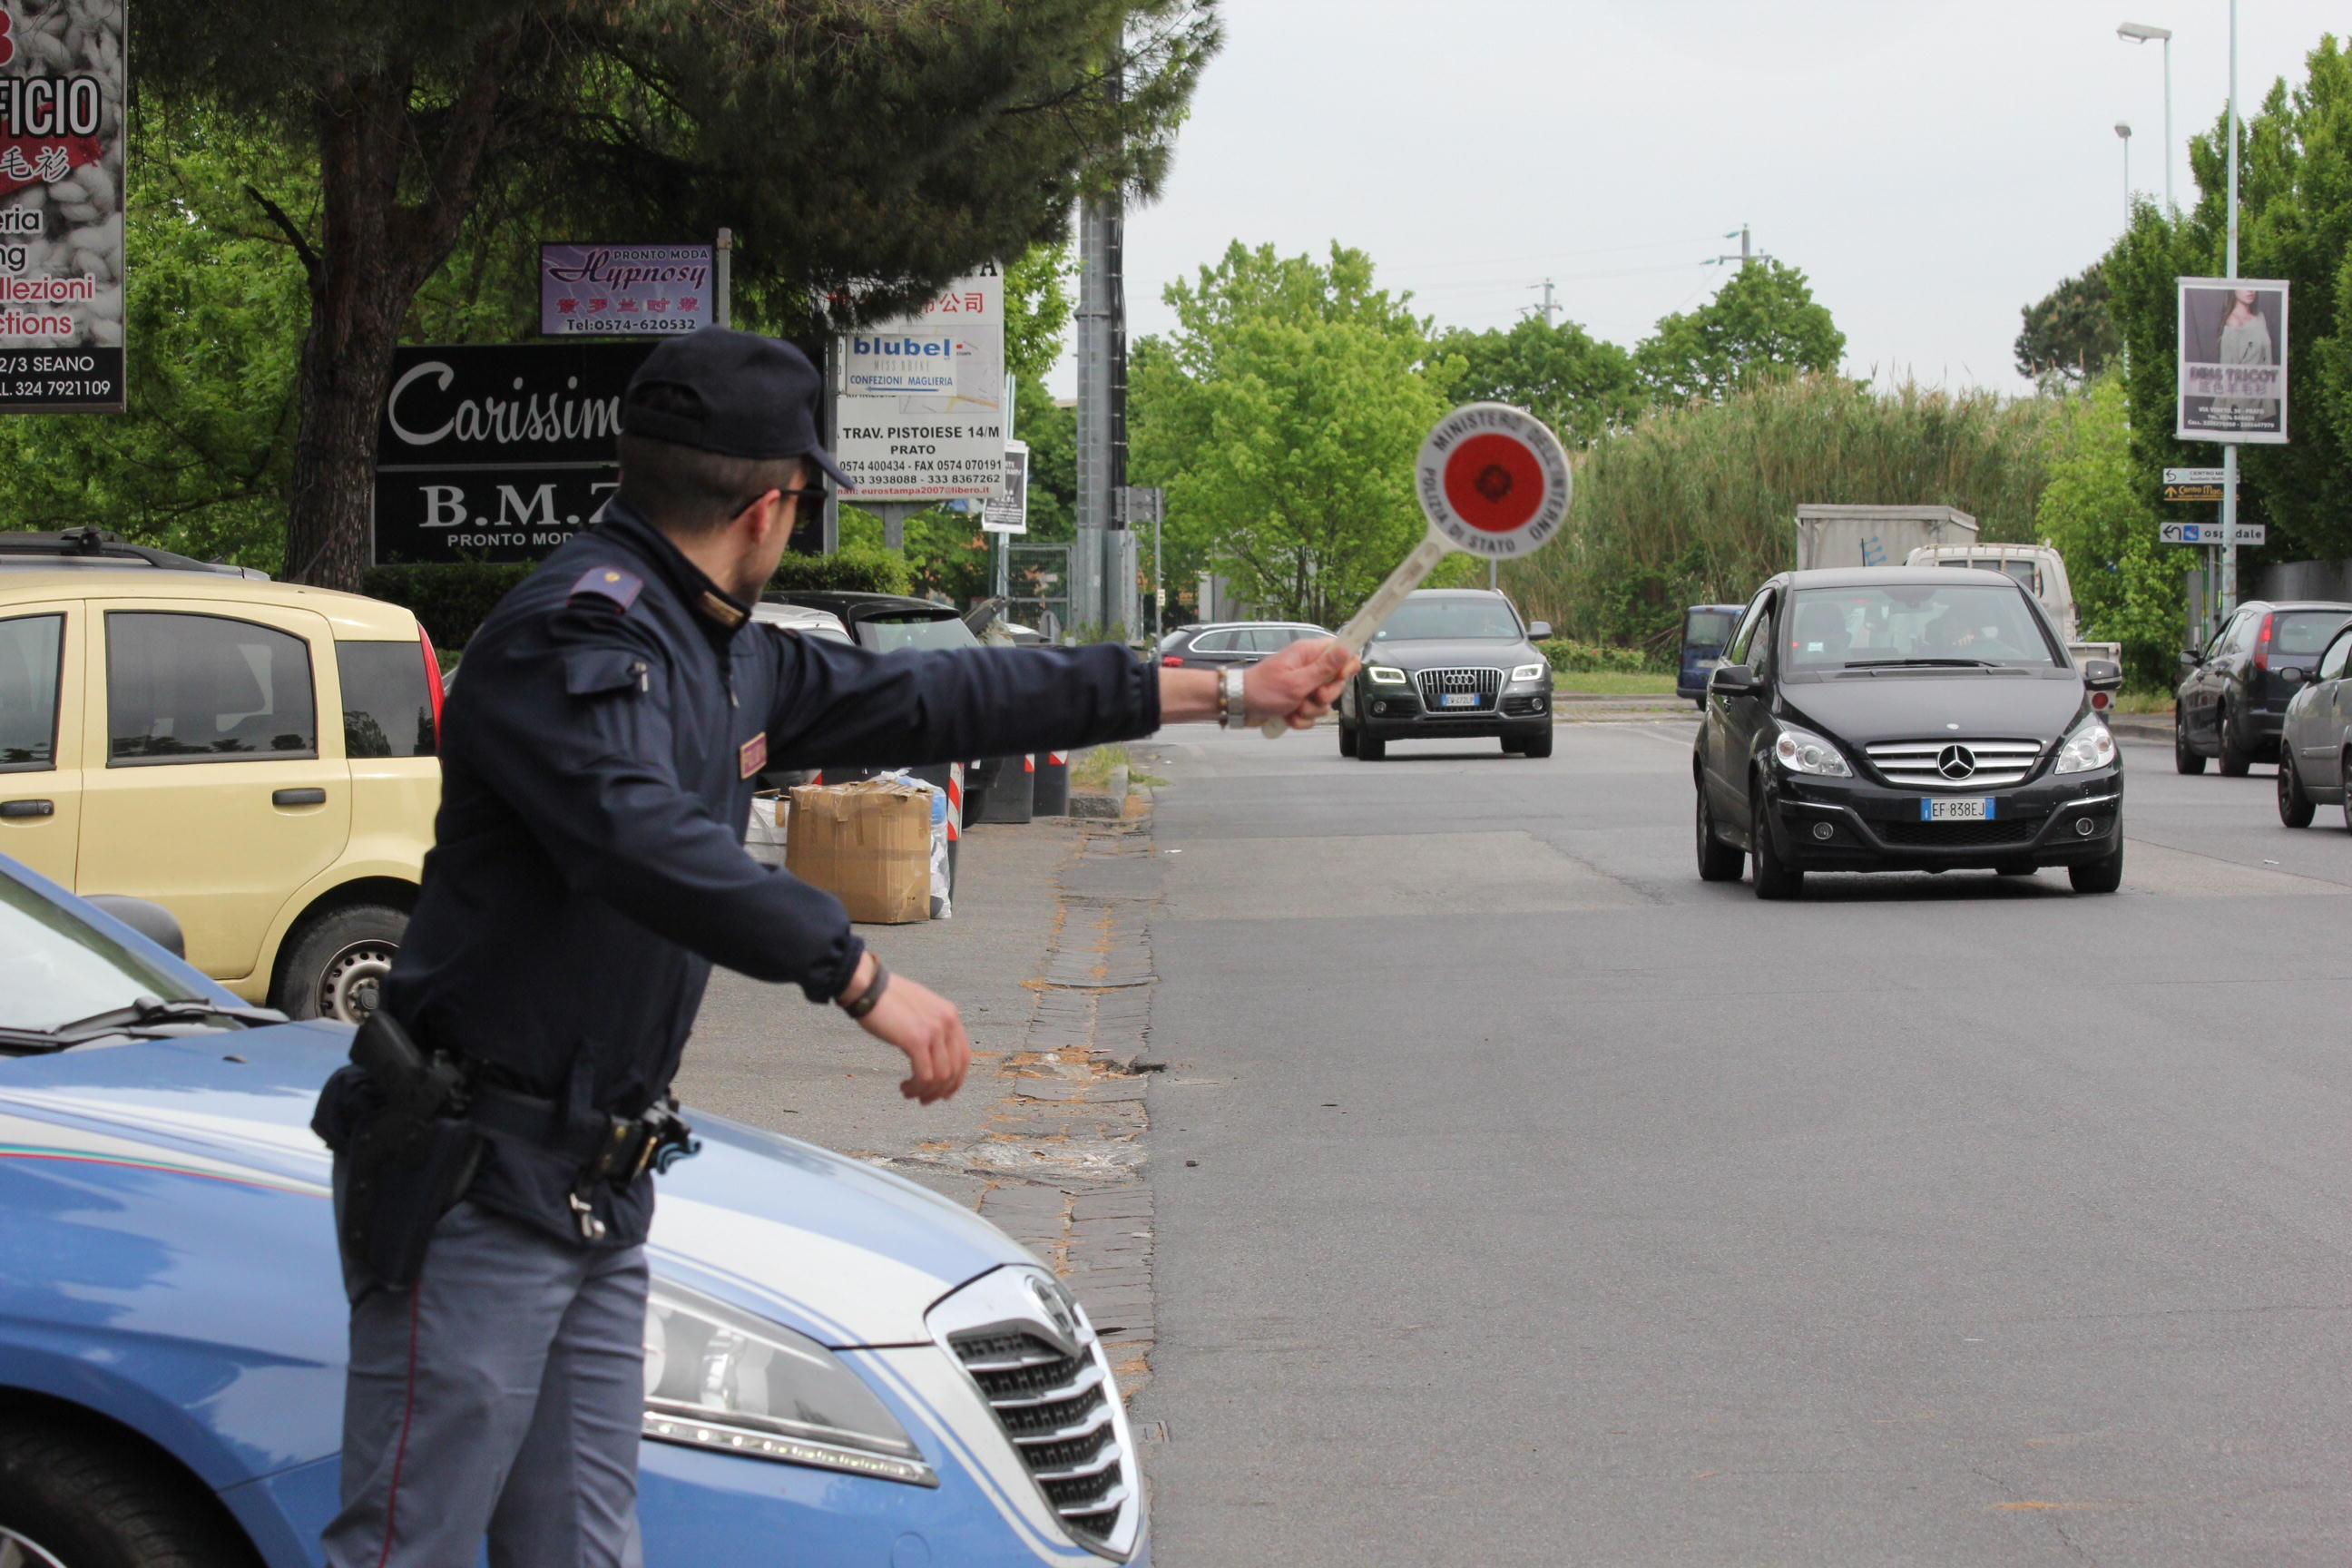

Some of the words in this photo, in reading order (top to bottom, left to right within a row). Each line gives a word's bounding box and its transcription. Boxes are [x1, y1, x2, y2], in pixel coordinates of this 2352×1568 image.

[0, 208, 39, 230] ria
[613, 250, 666, 260] PRONTO
[671, 250, 709, 260] MODA
[548, 250, 708, 290] Hypnosy
[566, 319, 696, 330] Tel:0574-620532
[854, 338, 950, 357] blubel
[33, 357, 94, 371] SEANO
[850, 375, 903, 386] CONFEZIONI
[908, 376, 953, 386] MAGLIERIA
[15, 382, 42, 396] 324
[47, 380, 111, 396] 7921109
[843, 427, 883, 438] TRAV.
[887, 426, 962, 438] PISTOIESE
[968, 426, 999, 438] 14/M
[890, 445, 936, 455] PRATO
[840, 461, 865, 471] 0574
[867, 460, 905, 471] 400434
[915, 460, 934, 470] FAX
[937, 460, 962, 470] 0574
[965, 460, 1002, 470] 070191
[868, 475, 916, 485] 3938088
[927, 475, 949, 484] 333
[952, 474, 1000, 484] 8367262
[861, 486, 990, 497] eurostampa2007@libero.it
[1422, 466, 1449, 524] POLIZIA
[1468, 534, 1516, 553] STATO
[447, 534, 526, 546] PRONTO
[2204, 529, 2261, 541] ospdale
[1932, 803, 1945, 817] EF
[1950, 802, 1984, 817] 838EJ
